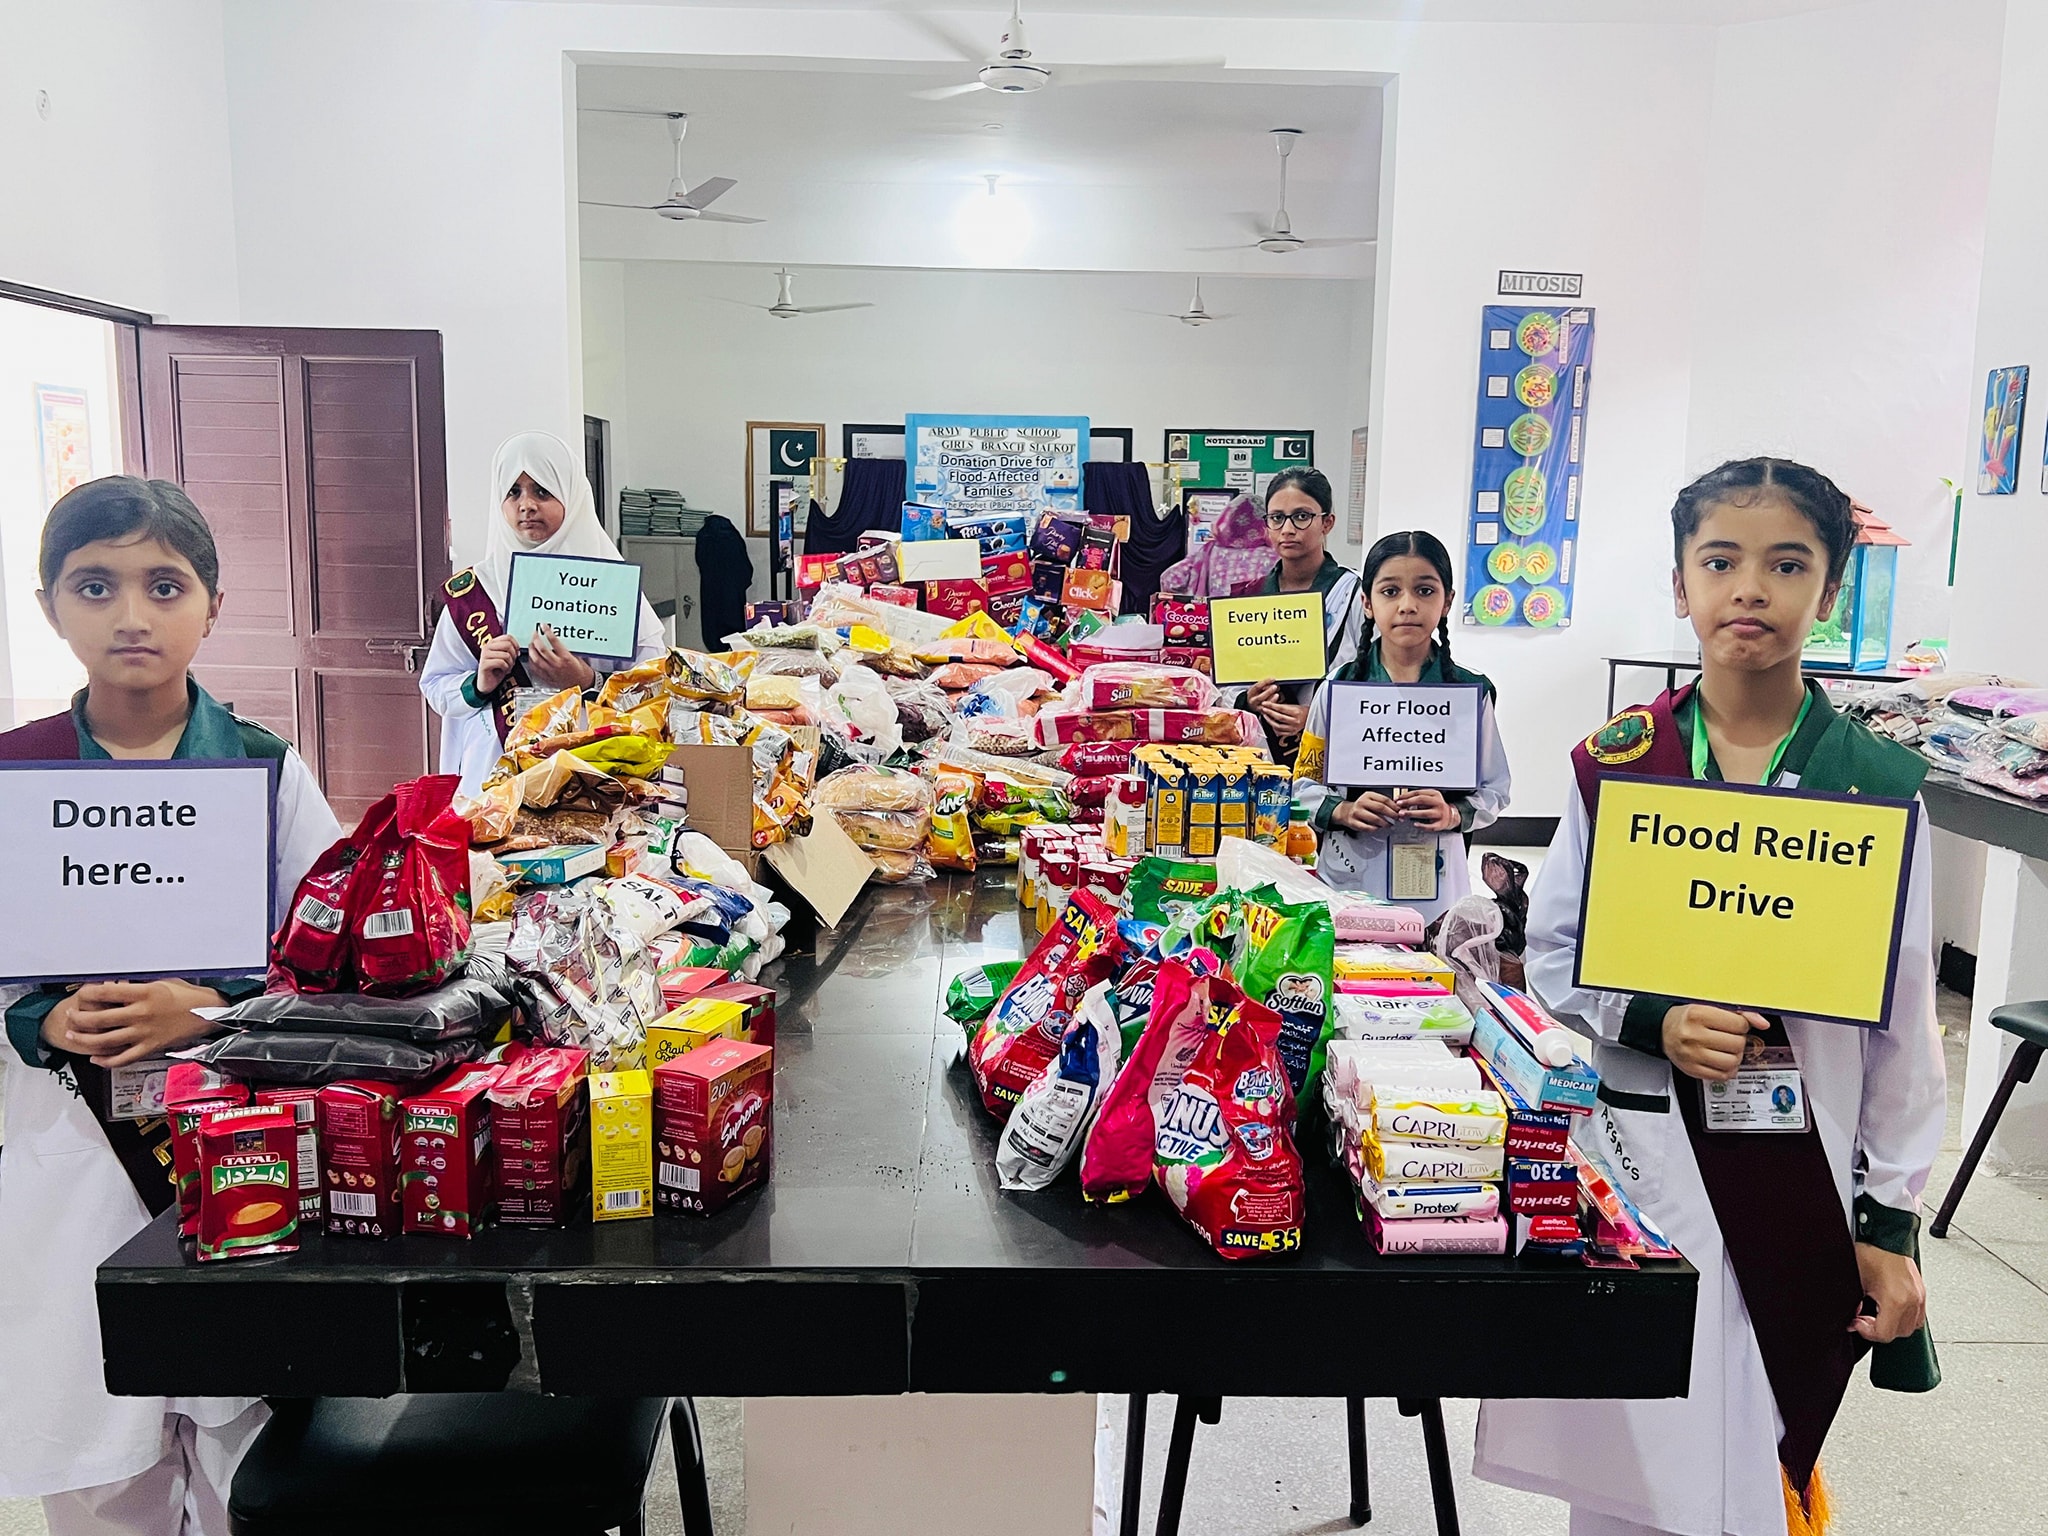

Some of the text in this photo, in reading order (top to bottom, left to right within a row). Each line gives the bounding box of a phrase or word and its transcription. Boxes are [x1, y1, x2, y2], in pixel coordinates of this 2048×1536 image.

[1502, 275, 1578, 293] MITOSIS
[929, 427, 1061, 438] ARMY PUBLIC SCHOOL
[941, 440, 1076, 453] GIRLS BRANCH SIALKOT
[940, 455, 1053, 467] Donation Drive for
[949, 470, 1039, 482] Flood-Affected
[964, 486, 1013, 497] Families
[959, 502, 987, 511] Prophet
[990, 501, 1016, 510] (PBUH)
[559, 572, 598, 588] Your
[1069, 586, 1099, 600] Click
[531, 596, 618, 616] Donations
[1228, 606, 1307, 626] Every item
[535, 622, 608, 642] Matter...
[1237, 632, 1300, 647] counts...
[1360, 700, 1451, 716] For Flood
[1181, 727, 1204, 739] Sun
[1361, 728, 1446, 745] Affected
[1363, 756, 1444, 773] Families
[936, 796, 966, 813] ANG
[52, 799, 197, 828] Donate
[1629, 813, 1875, 868] Flood Relief
[61, 856, 186, 886] here...
[1164, 879, 1204, 896] SAVE
[621, 880, 679, 921] SALT
[1687, 879, 1795, 919] Drive
[1396, 921, 1422, 932] LUX
[1268, 993, 1322, 1015] Softlan
[1353, 996, 1441, 1009] Guarex
[1548, 1076, 1595, 1093] MEDICAM
[994, 1086, 1020, 1103] SAVE
[410, 1107, 450, 1117] TAPAL
[1161, 1089, 1232, 1148] NUS
[720, 1095, 763, 1150] Supreme
[1392, 1115, 1460, 1141] CAPRI
[1508, 1138, 1565, 1154] Sparkle
[1600, 1105, 1640, 1182] APSACS
[223, 1155, 277, 1167] TAPAL
[1402, 1160, 1468, 1179] CAPRI
[1531, 1163, 1562, 1181] 230
[1413, 1201, 1462, 1215] Protex
[1513, 1194, 1572, 1208] Sparkle
[1225, 1232, 1259, 1247] SAVE
[1270, 1227, 1299, 1252] 35
[1387, 1240, 1419, 1252] LUX
